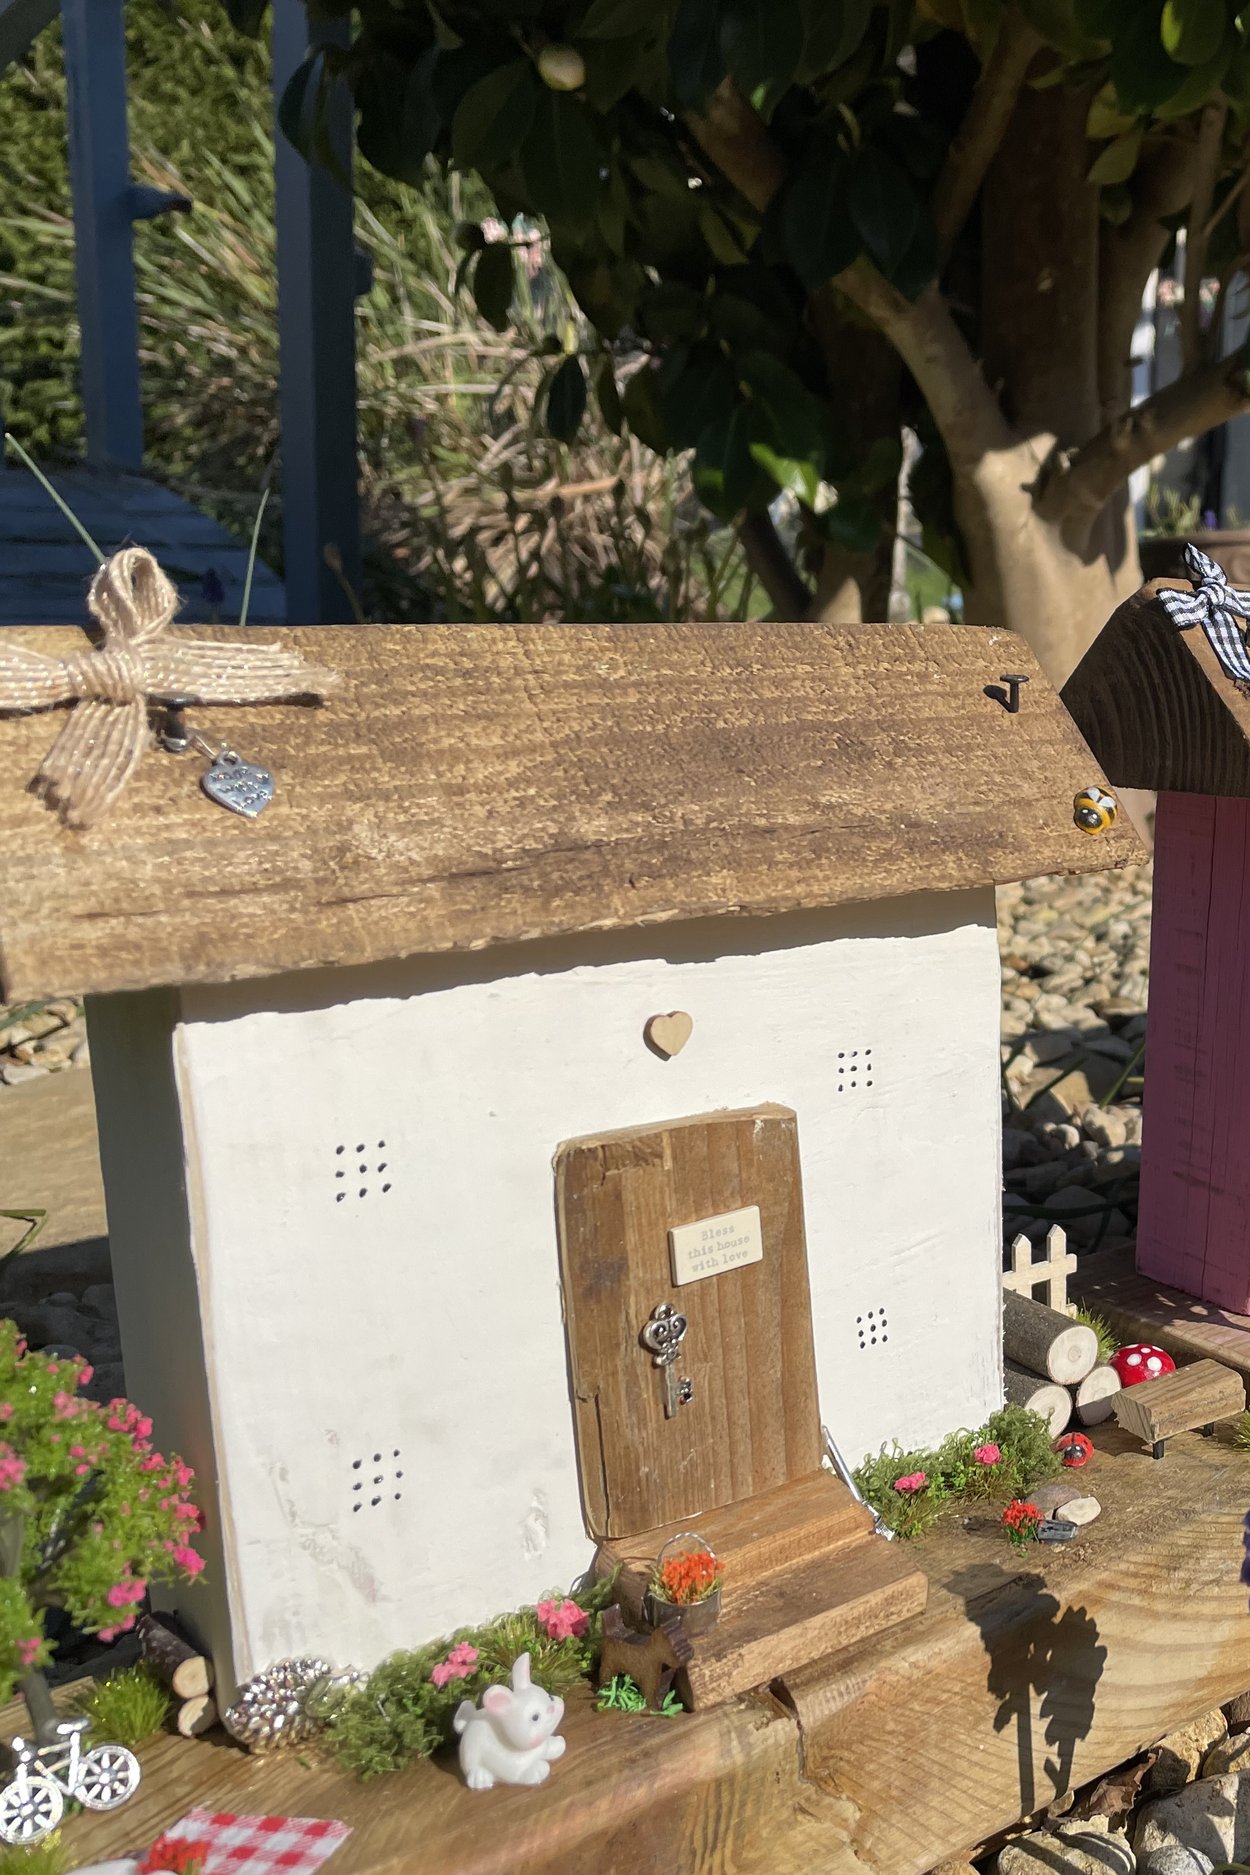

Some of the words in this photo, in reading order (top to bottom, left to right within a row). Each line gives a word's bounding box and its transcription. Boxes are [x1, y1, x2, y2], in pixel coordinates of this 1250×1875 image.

[701, 1225, 735, 1241] Bless
[688, 1245, 714, 1259] this
[717, 1235, 750, 1251] house
[692, 1257, 719, 1272] with
[723, 1250, 748, 1264] love
